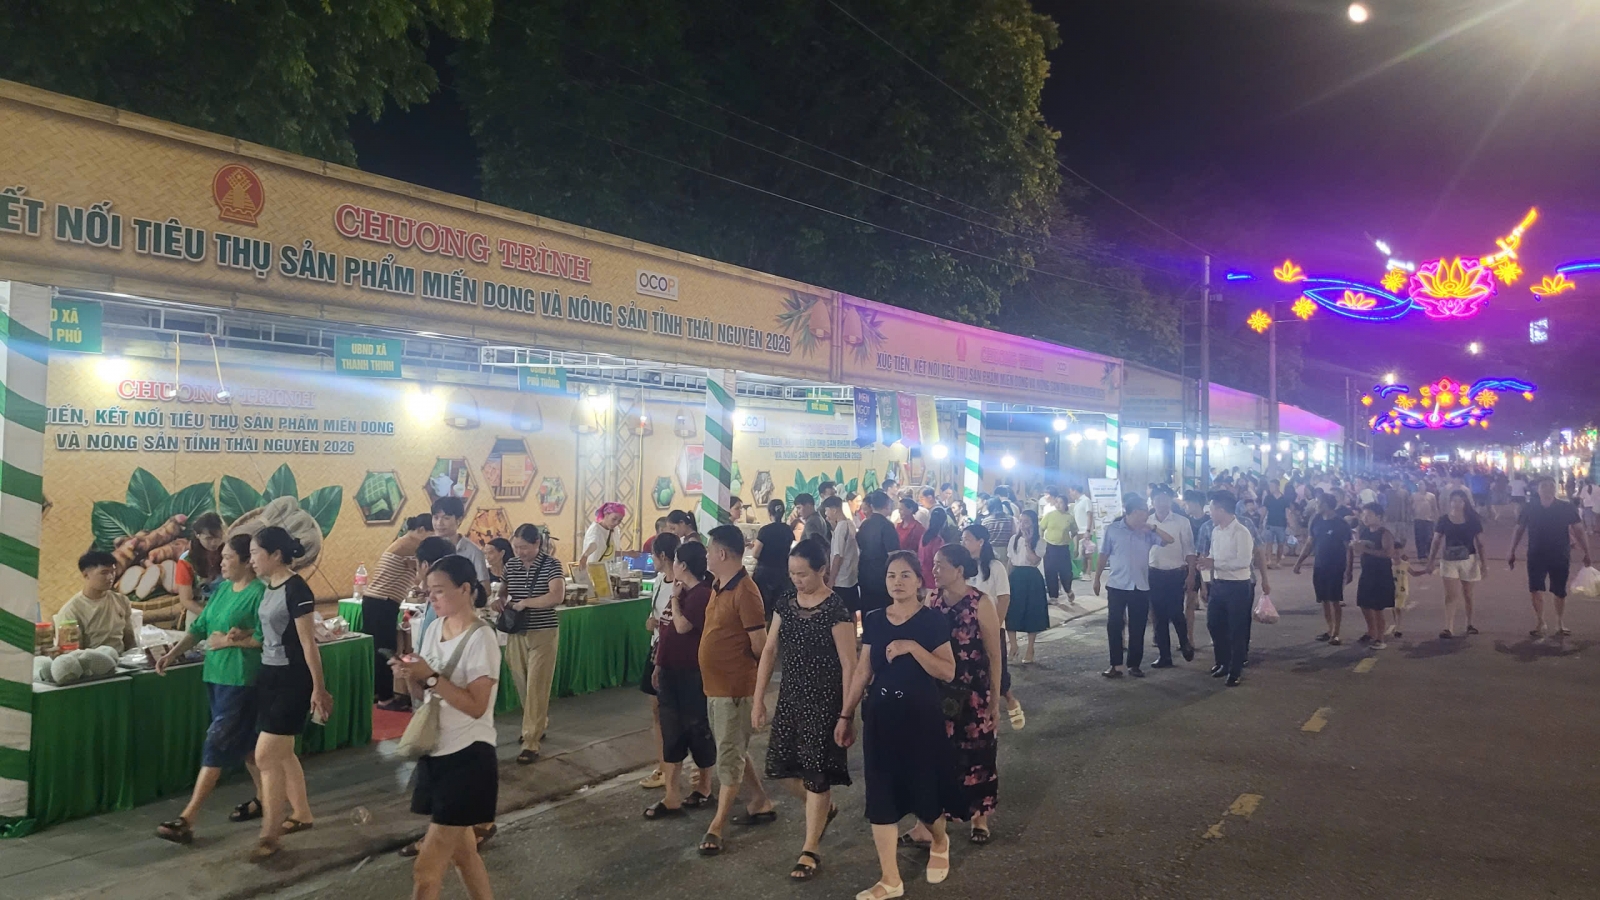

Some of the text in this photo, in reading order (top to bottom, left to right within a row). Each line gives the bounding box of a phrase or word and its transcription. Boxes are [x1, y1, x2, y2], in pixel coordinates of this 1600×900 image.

[334, 203, 591, 283] CHƯƠNG TRÌNH
[56, 201, 122, 249] NỐI
[132, 217, 206, 261] TIÊU
[214, 232, 271, 278] THỤ
[280, 239, 337, 283] SẢN
[344, 253, 415, 295] PHẨM
[421, 268, 477, 305] MIẾN
[482, 281, 535, 314] DONG
[540, 290, 563, 318] VÀ
[567, 295, 613, 326] NÔNG
[617, 301, 647, 331] SẢN
[651, 306, 682, 337] TỈNH
[686, 316, 714, 343] THÁI
[717, 325, 763, 350] NGUYÊN
[765, 332, 791, 354] 2026
[639, 273, 675, 292] OCOP
[61, 308, 79, 324] XÃ
[352, 343, 374, 355] UBND
[95, 406, 129, 426] KẾT
[133, 407, 165, 427] NỐI
[169, 410, 205, 428] TIÊU
[209, 413, 239, 433] THỤ
[243, 412, 274, 431] SẢN
[278, 413, 319, 432] PHẨM
[323, 415, 357, 434] MIẾN
[360, 420, 394, 435] DONG
[56, 430, 355, 454] VÀ NÔNG SẢN TỈNH THÁI NGUYÊN 2026
